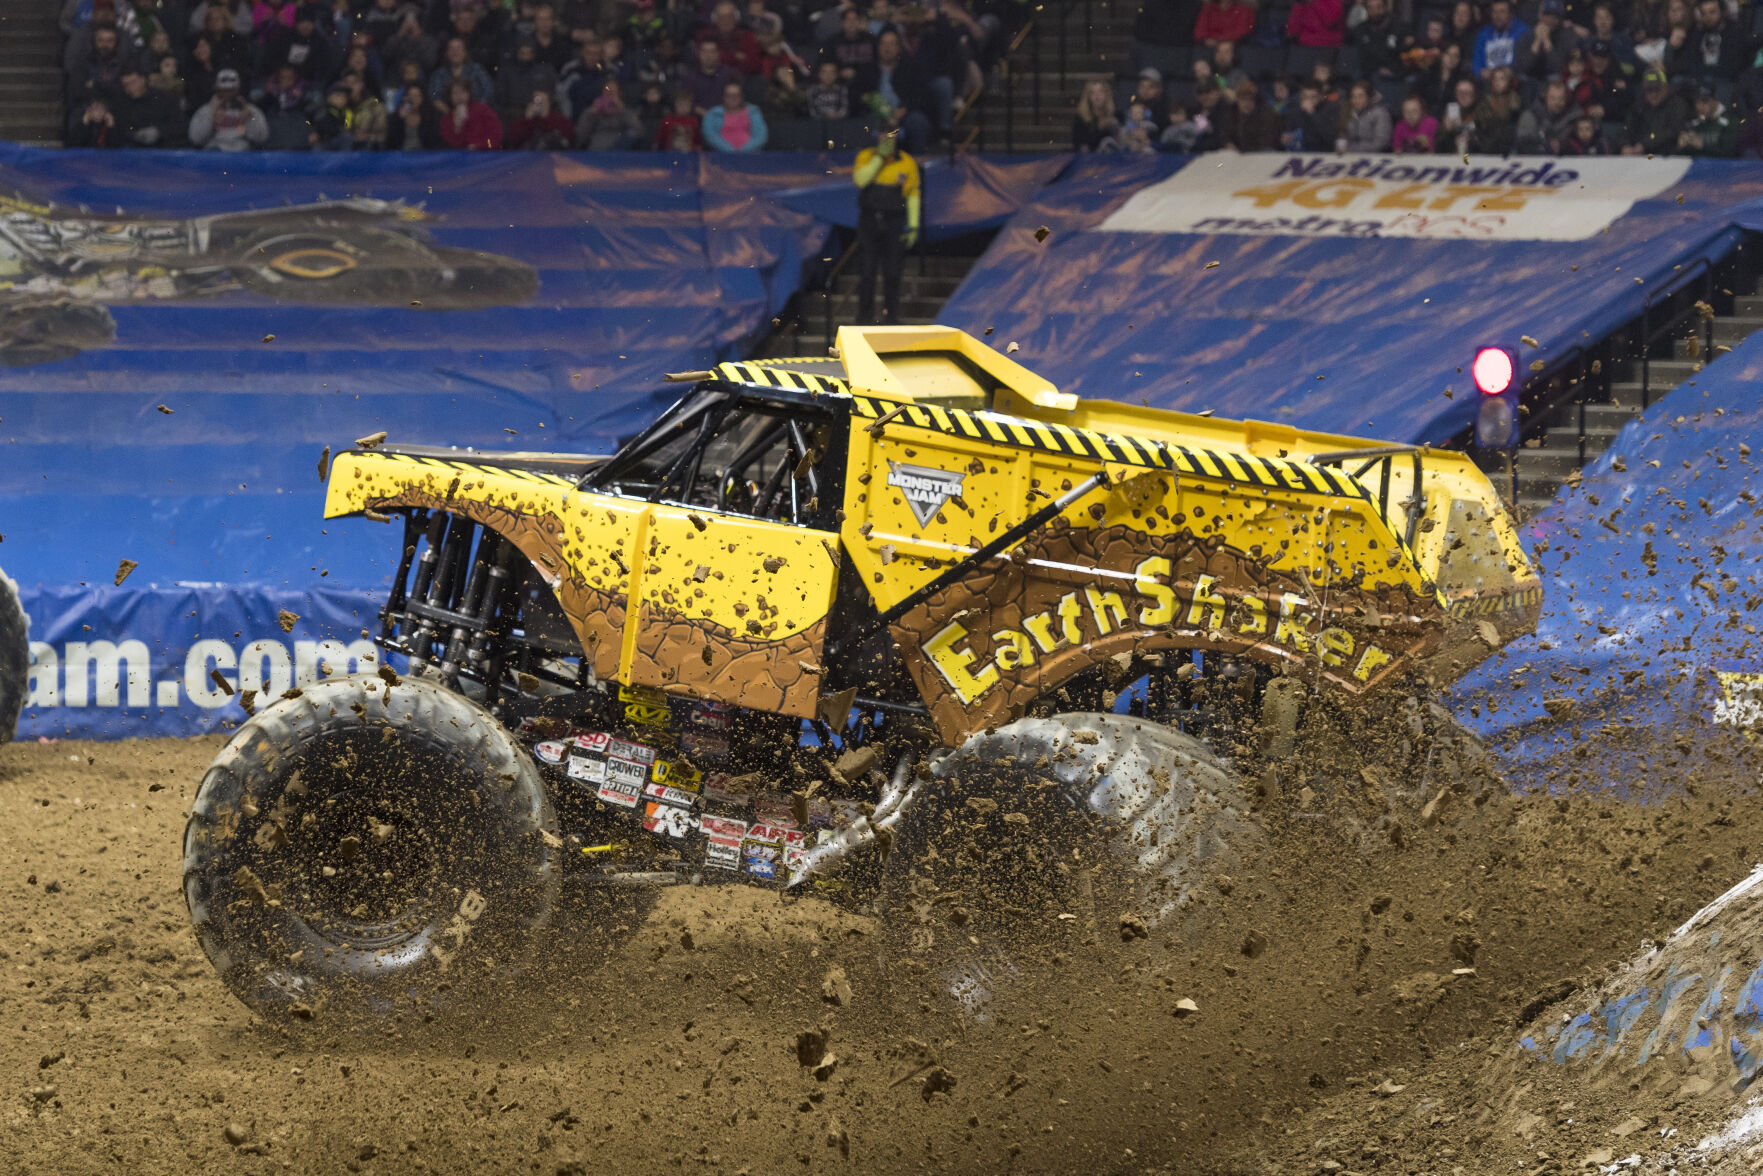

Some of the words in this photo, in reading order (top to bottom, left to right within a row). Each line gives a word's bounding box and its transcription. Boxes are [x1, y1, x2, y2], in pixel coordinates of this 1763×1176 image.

[1271, 158, 1580, 188] Nationwide
[1232, 176, 1376, 210] 4G
[1372, 184, 1560, 211] LTE
[888, 472, 963, 497] MONSTER
[908, 489, 943, 505] JAM
